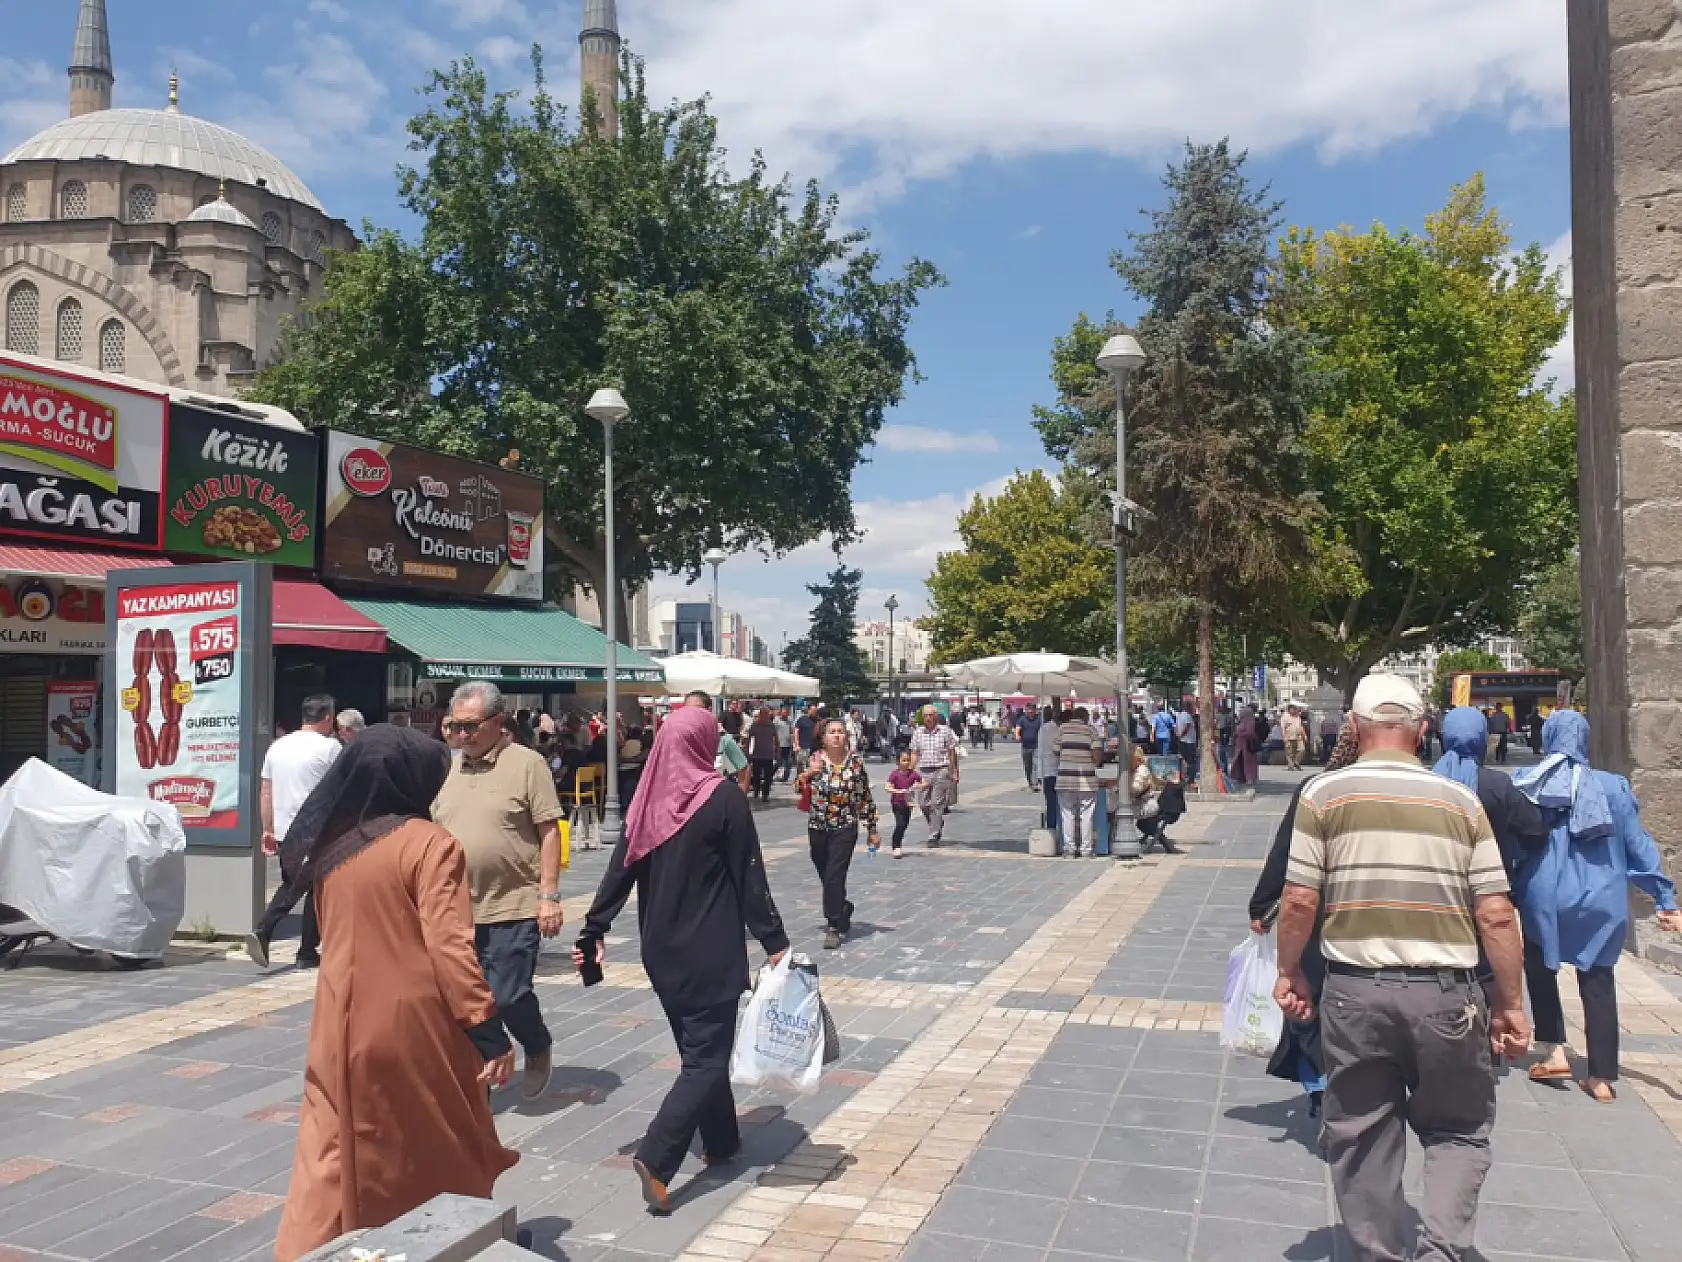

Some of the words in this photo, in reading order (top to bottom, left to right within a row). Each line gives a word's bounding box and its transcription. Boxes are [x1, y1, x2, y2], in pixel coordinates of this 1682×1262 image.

[0, 476, 141, 535] AĞASI
[171, 474, 310, 542] KURUYEMİŞ
[122, 598, 147, 614] YAZ
[148, 588, 235, 612] KAMPANYASI
